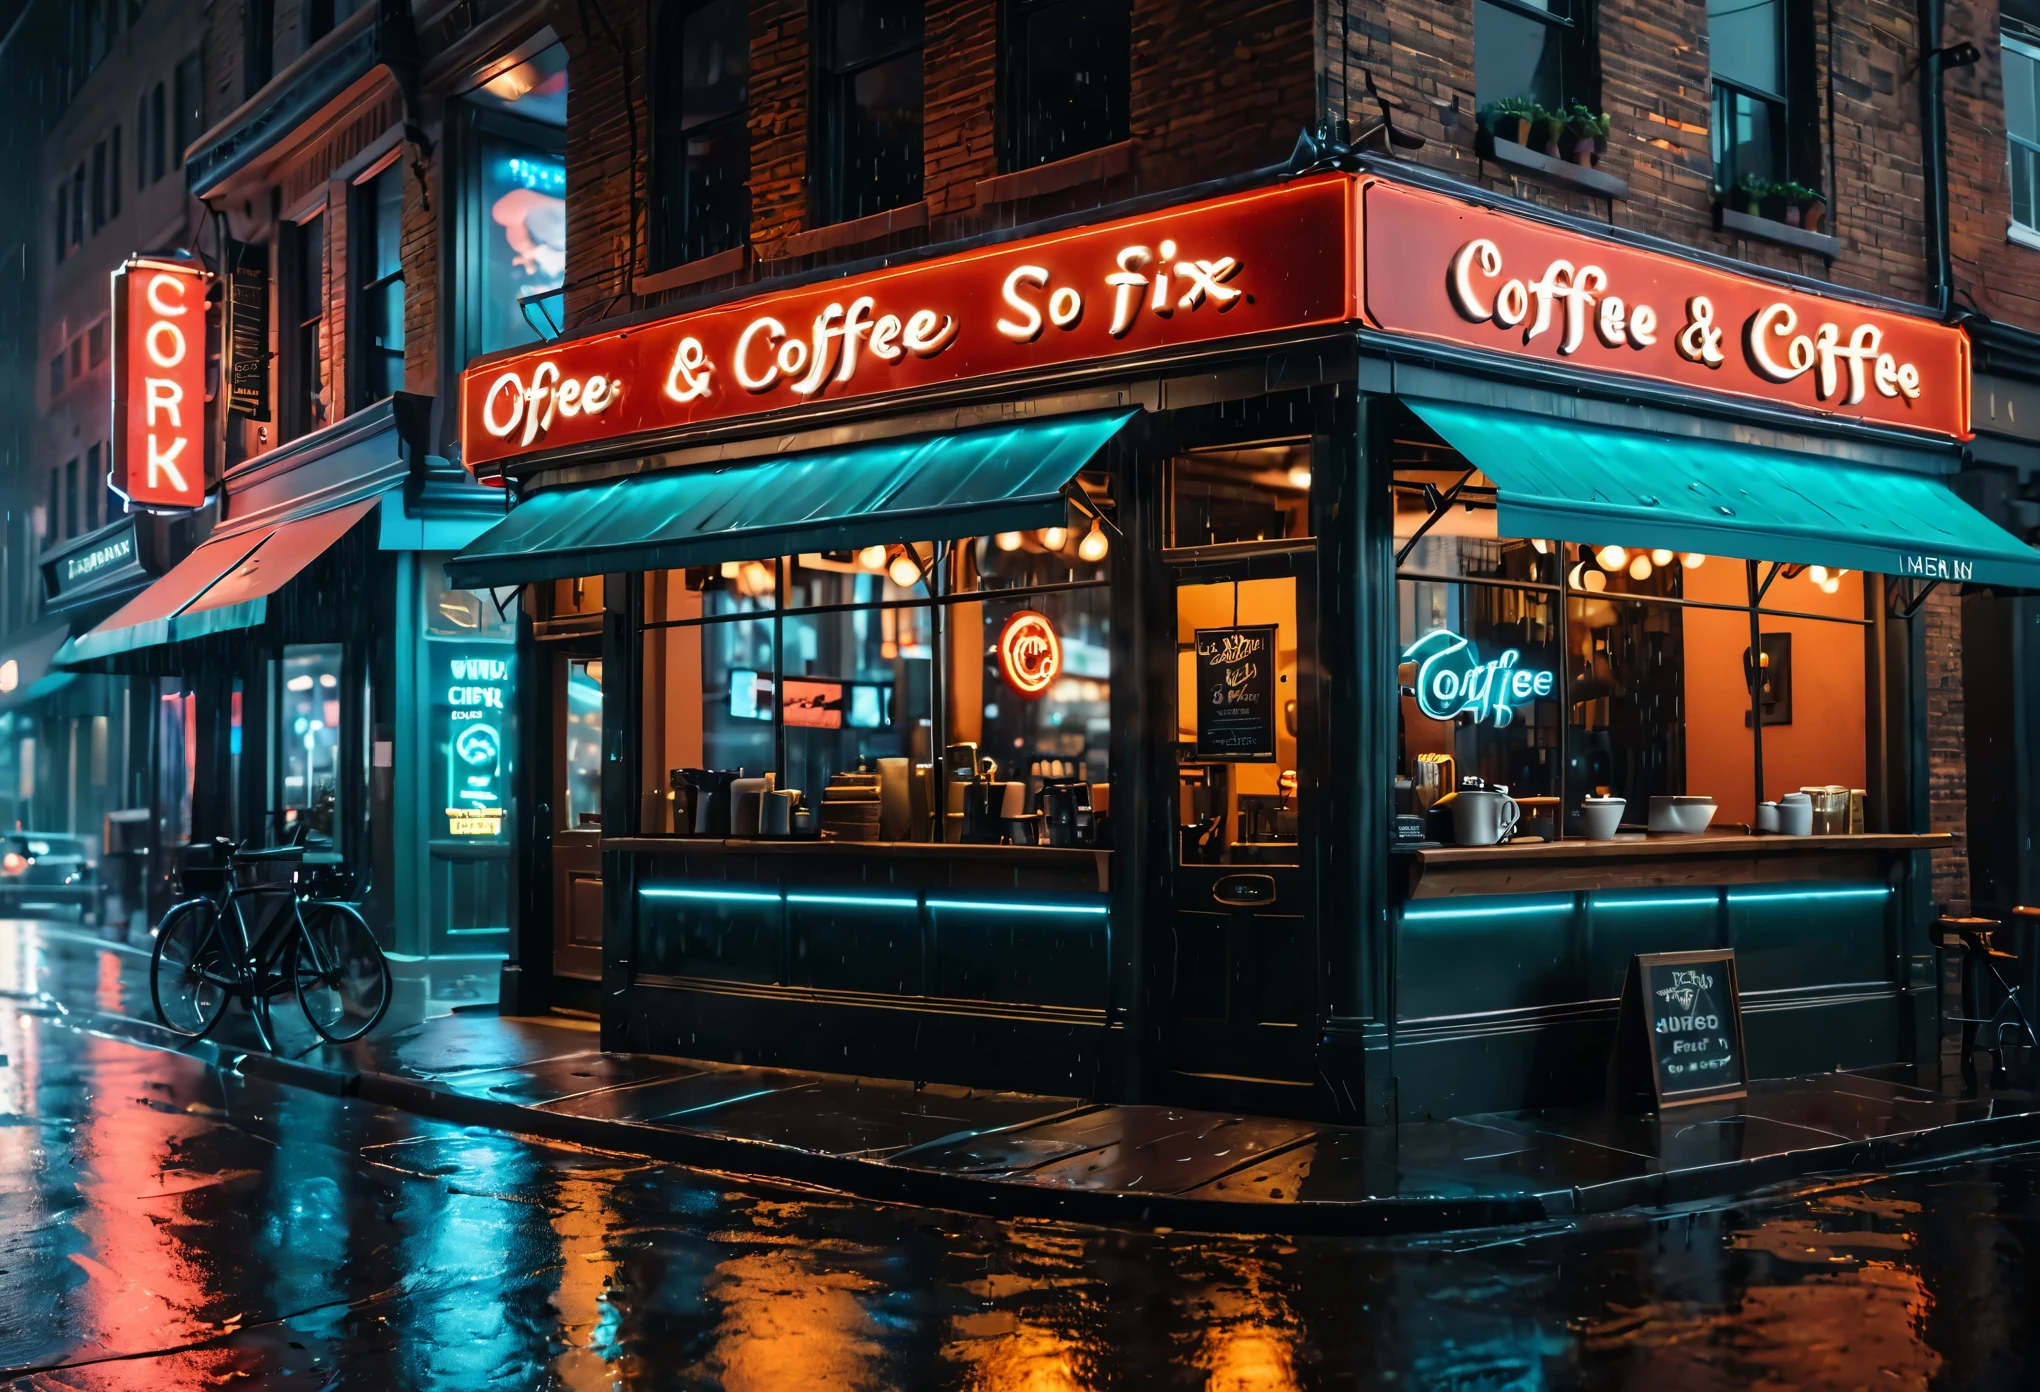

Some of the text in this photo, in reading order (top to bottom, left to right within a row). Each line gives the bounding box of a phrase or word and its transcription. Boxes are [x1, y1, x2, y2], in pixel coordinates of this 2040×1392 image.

[145, 273, 189, 493] CORK
[664, 336, 713, 403] &
[732, 295, 955, 395] Coffee
[996, 264, 1083, 343] So
[1448, 238, 1922, 407] Coffee & Coffee
